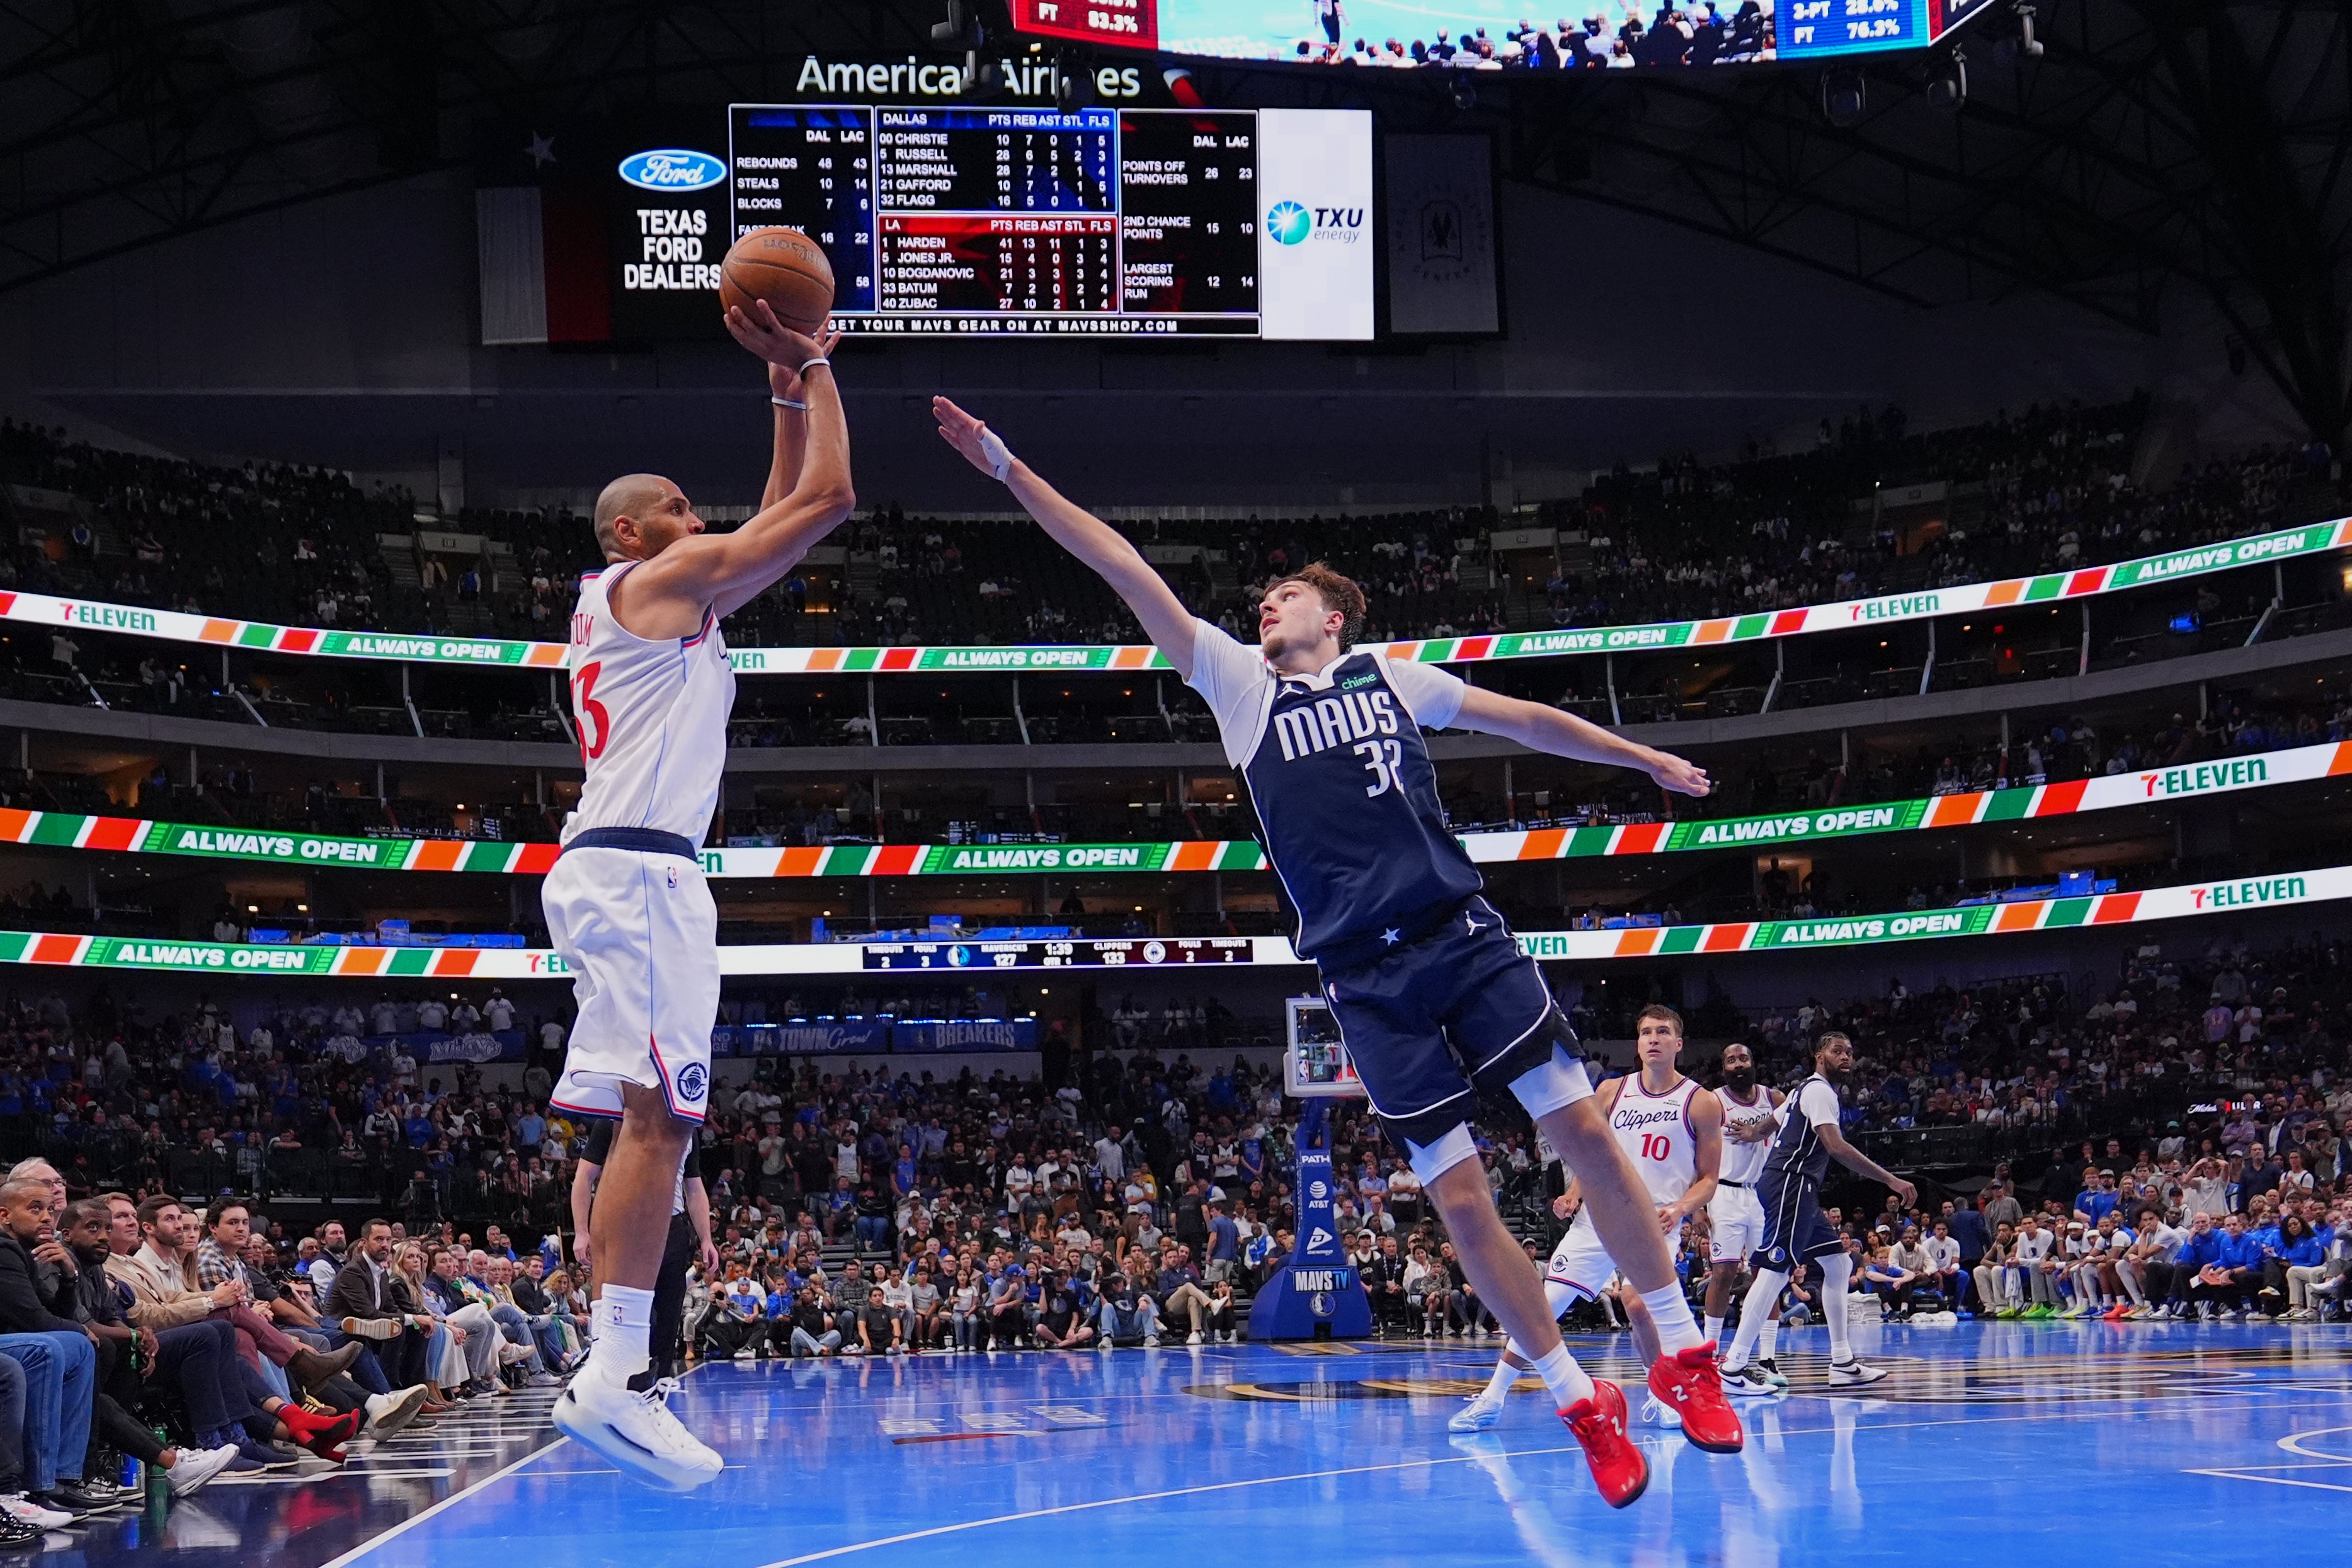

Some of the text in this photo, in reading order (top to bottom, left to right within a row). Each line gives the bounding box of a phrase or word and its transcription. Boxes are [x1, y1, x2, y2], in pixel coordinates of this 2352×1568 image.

[1039, 2, 1058, 21] FT
[1794, 18, 1900, 44] FT 76.3%
[797, 55, 968, 95] America
[882, 113, 1110, 127] DALLAS PTS REB AST STL FLS
[806, 130, 864, 143] DAL LAC
[879, 132, 1010, 146] 00 CHRISTIE 10
[1193, 135, 1249, 148] DAL LAC
[895, 148, 948, 161] RUSSELL
[996, 149, 1010, 161] 28
[640, 155, 705, 184] Ford
[736, 157, 867, 169] REBOUNDS 48 43
[881, 163, 1010, 176] 13 MARSHALL 28
[1122, 160, 1253, 179] POINTS OFF 26 23
[737, 178, 867, 190] STEALS 10 14
[880, 178, 1011, 191] 21 GAFFORD 10
[1122, 173, 1189, 185] TURNOVERS
[738, 198, 868, 210] BLOCKS 7 6
[881, 193, 1011, 207] 32 FLAGG 16
[636, 209, 707, 236] TEXAS
[885, 219, 1112, 232] LA PTS REB AST STL FLS
[1123, 215, 1253, 234] 2ND CHANCE 15 10
[1314, 208, 1364, 228] TXU
[821, 232, 834, 243] 16
[855, 232, 869, 244] 22
[1123, 228, 1163, 239] POINTS
[1313, 229, 1360, 244] energy
[643, 236, 702, 263] FORD
[882, 237, 1012, 248] 1 HARDEN 41
[897, 252, 936, 264] JONES
[937, 252, 956, 263] JR.
[999, 253, 1012, 264] 15
[882, 267, 1013, 279] 10 BOGDANOVIC 21
[1124, 263, 1173, 274] LARGEST
[624, 263, 722, 290] DEALERS
[855, 276, 870, 287] 58
[1124, 275, 1253, 287] SCORING 12 14
[882, 282, 1013, 294] 33 BATUM 7
[1124, 288, 1148, 299] RUN
[882, 297, 1013, 309] 40 ZUBAC 27
[828, 318, 1177, 333] GET YOUR MAVS GEAR ON AT MAVSSHOP.COM
[2138, 533, 2305, 579] ALWAYS OPEN
[1519, 628, 1667, 652] ALWAYS OPEN
[347, 638, 501, 659] ALWAYS OPEN
[944, 651, 1088, 666] ALWAYS OPEN
[1341, 673, 1378, 690] chime
[1274, 691, 1398, 762] MAVS
[1353, 739, 1405, 798] 32
[1699, 808, 1894, 843] ALWAYS OPEN
[179, 831, 377, 861] ALWAYS OPEN
[954, 849, 1138, 867] ALWAYS OPEN
[1782, 914, 1963, 943] ALWAYS OPEN
[866, 945, 903, 954] TIMEOUTS
[981, 944, 1028, 953] MAVERICKS
[1044, 943, 1073, 956] 1:39
[1093, 942, 1133, 951] CLIPPERS
[1178, 940, 1202, 948] FOULS
[1211, 940, 1247, 948] TIMEOUTS
[117, 945, 305, 969] ALWAYS OPEN
[527, 955, 569, 972] 7-EL
[881, 955, 891, 969] 2
[921, 955, 930, 968] 3
[993, 953, 1017, 967] 127
[1102, 952, 1126, 965] 133
[1185, 951, 1195, 963] 2
[1225, 950, 1234, 963] 2
[779, 1028, 828, 1051] TOWN
[935, 1023, 1015, 1048] BREAKERS
[1614, 1110, 1678, 1130] Clippers
[1641, 1133, 1670, 1161] 10
[1302, 1155, 1330, 1163] PATH
[1309, 1200, 1329, 1208] AT&T
[1295, 1271, 1333, 1291] MAVS
[1333, 1271, 1347, 1290] TV
